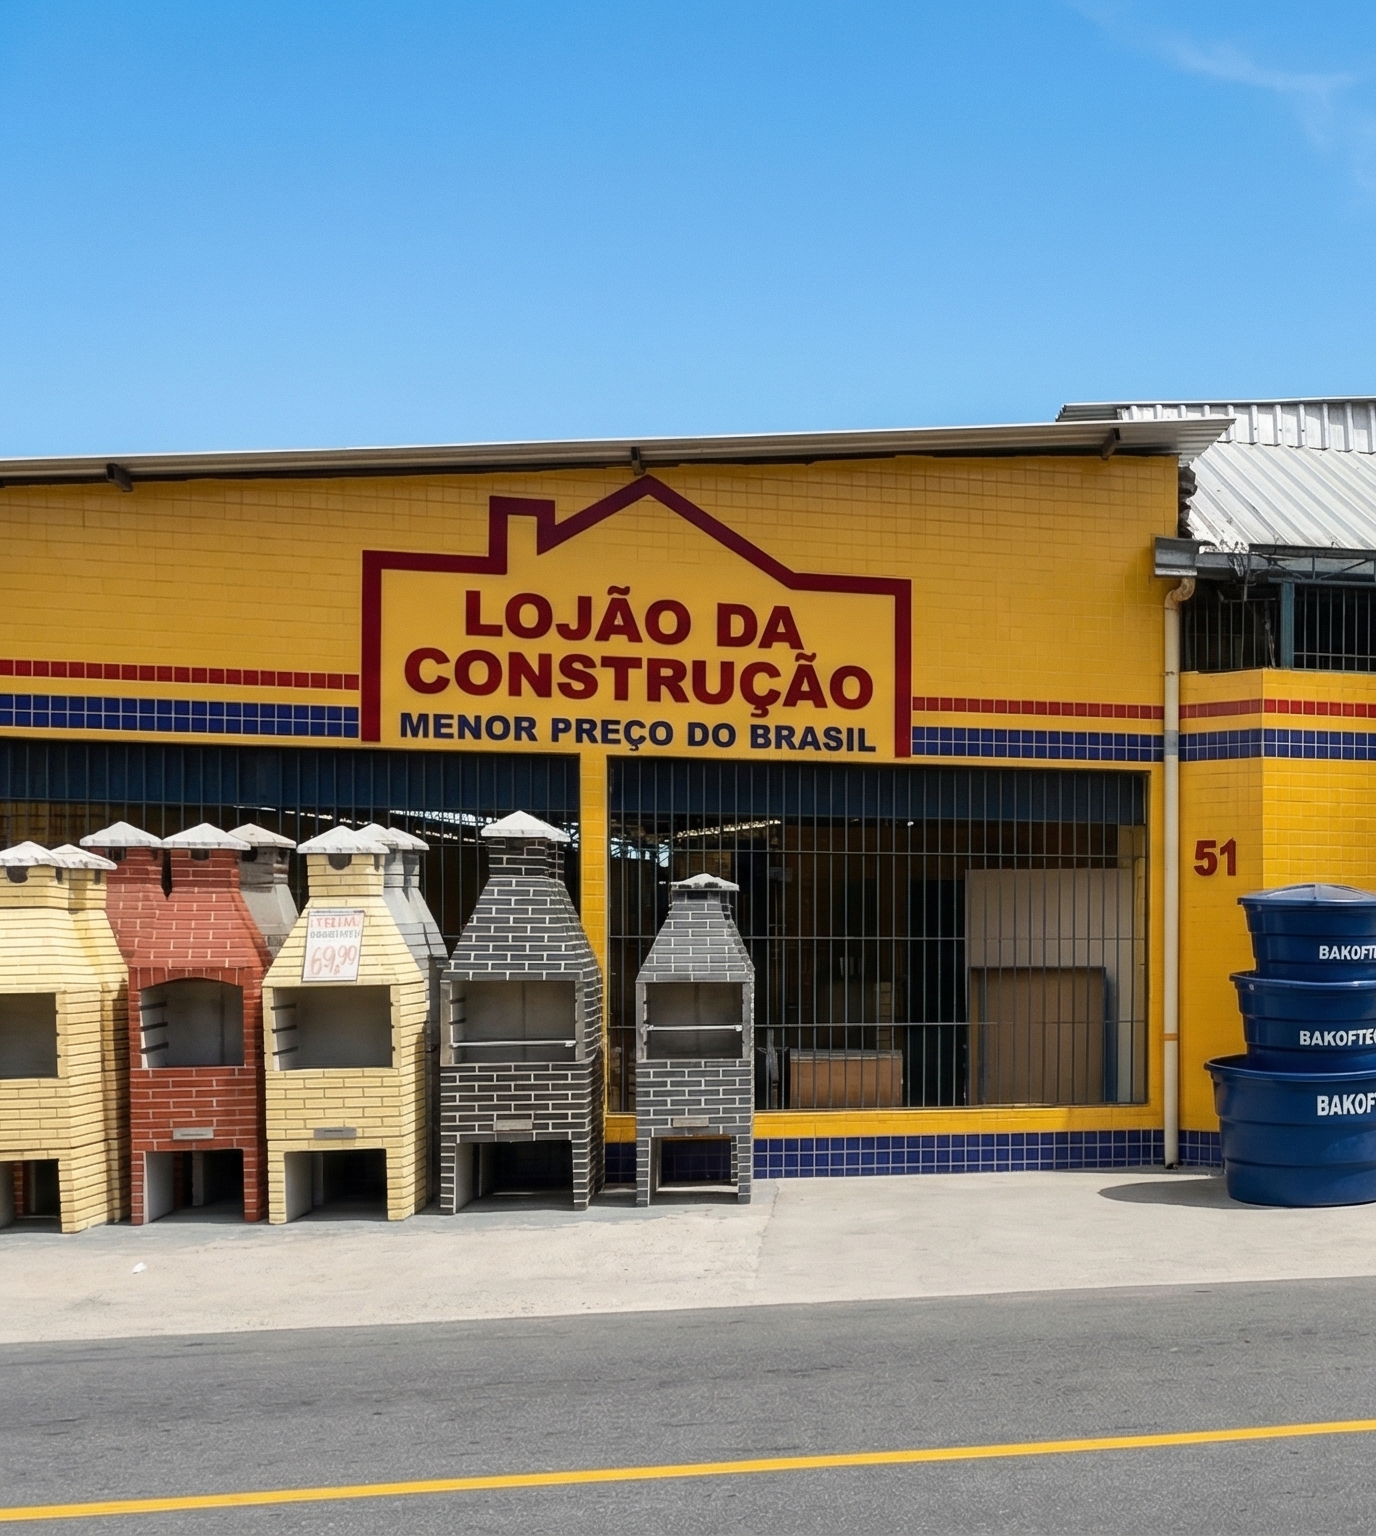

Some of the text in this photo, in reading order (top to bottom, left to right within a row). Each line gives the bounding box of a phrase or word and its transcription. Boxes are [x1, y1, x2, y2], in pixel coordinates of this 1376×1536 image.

[465, 585, 805, 650] LOJÃO DA
[404, 647, 874, 717] CONSTRUÇÃO
[399, 712, 877, 753] MENOR PREÇO DO BRASIL
[1193, 837, 1237, 877] 51
